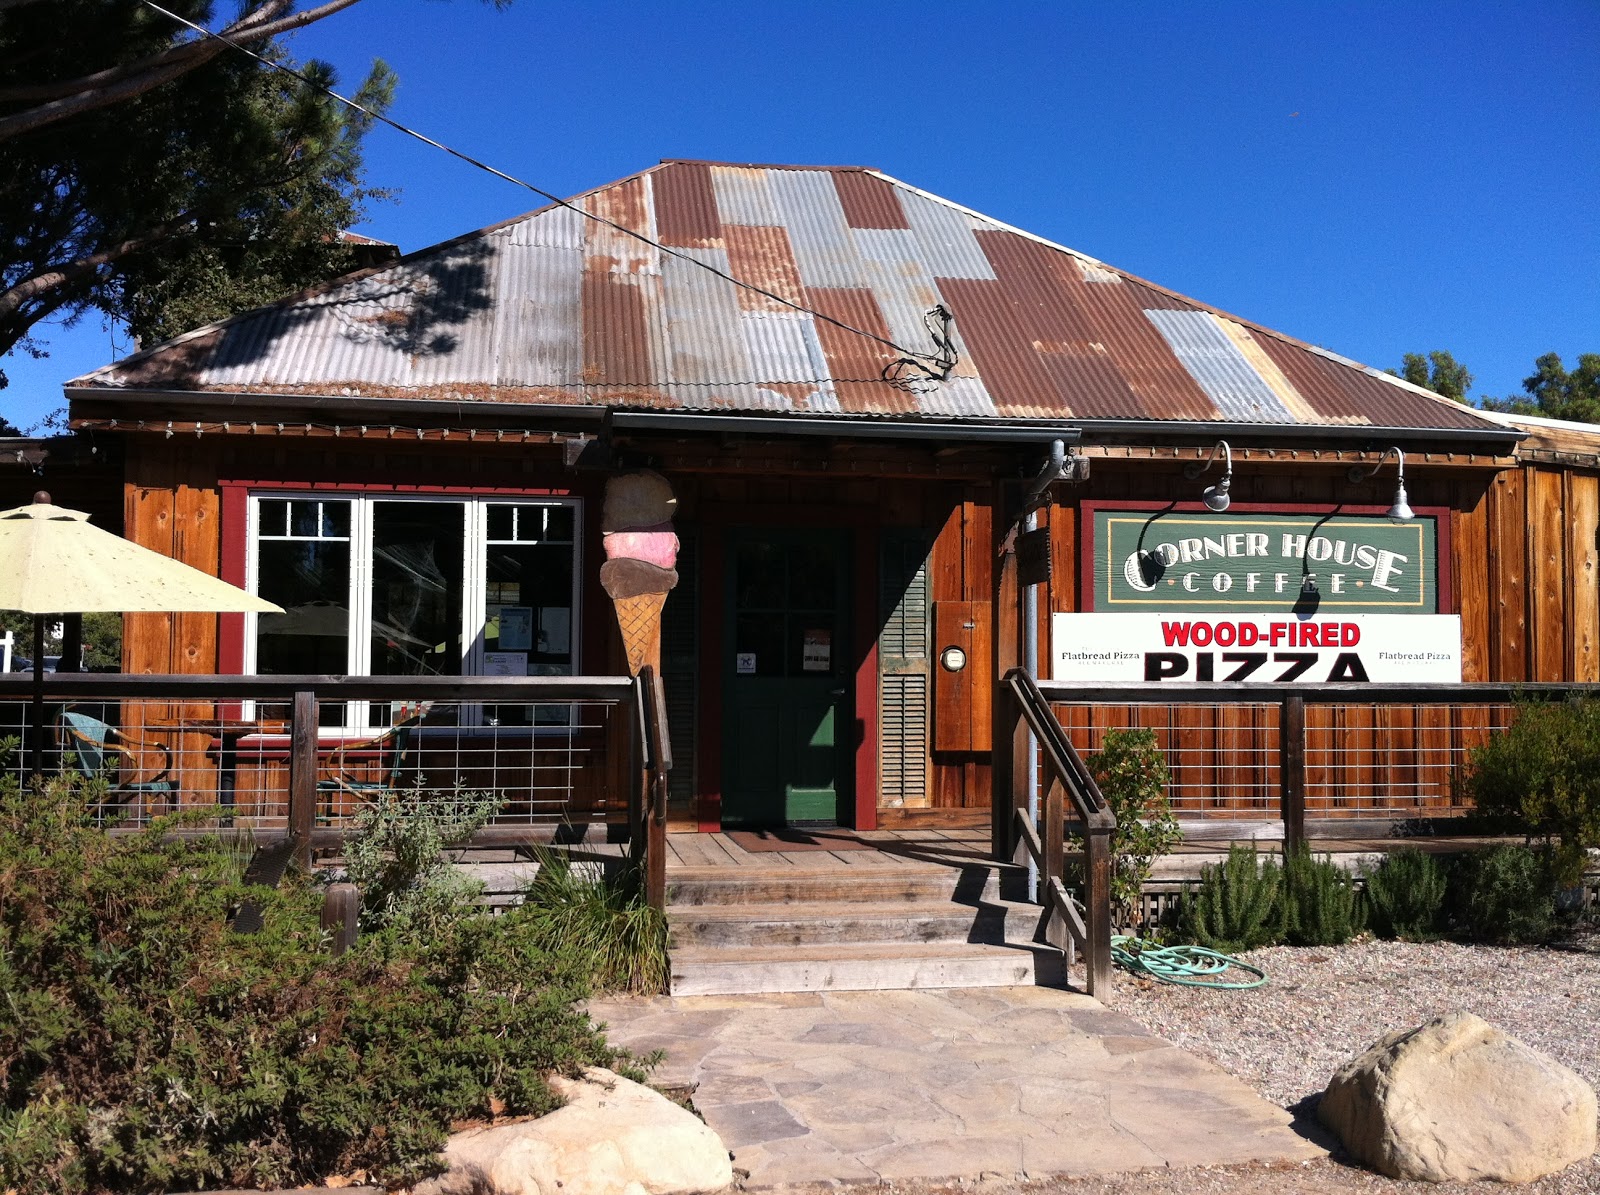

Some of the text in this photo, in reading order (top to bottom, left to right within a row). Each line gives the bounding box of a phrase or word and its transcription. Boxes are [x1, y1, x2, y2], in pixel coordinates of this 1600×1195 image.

[1124, 532, 1409, 593] CORNER HOUSE
[1182, 572, 1346, 594] COFFEE
[1161, 621, 1361, 647] WOOD-FIRED
[1061, 651, 1140, 660] Flatbread Pizza
[1144, 652, 1370, 682] PIZZA
[1379, 651, 1451, 660] Flatbread Pizza
